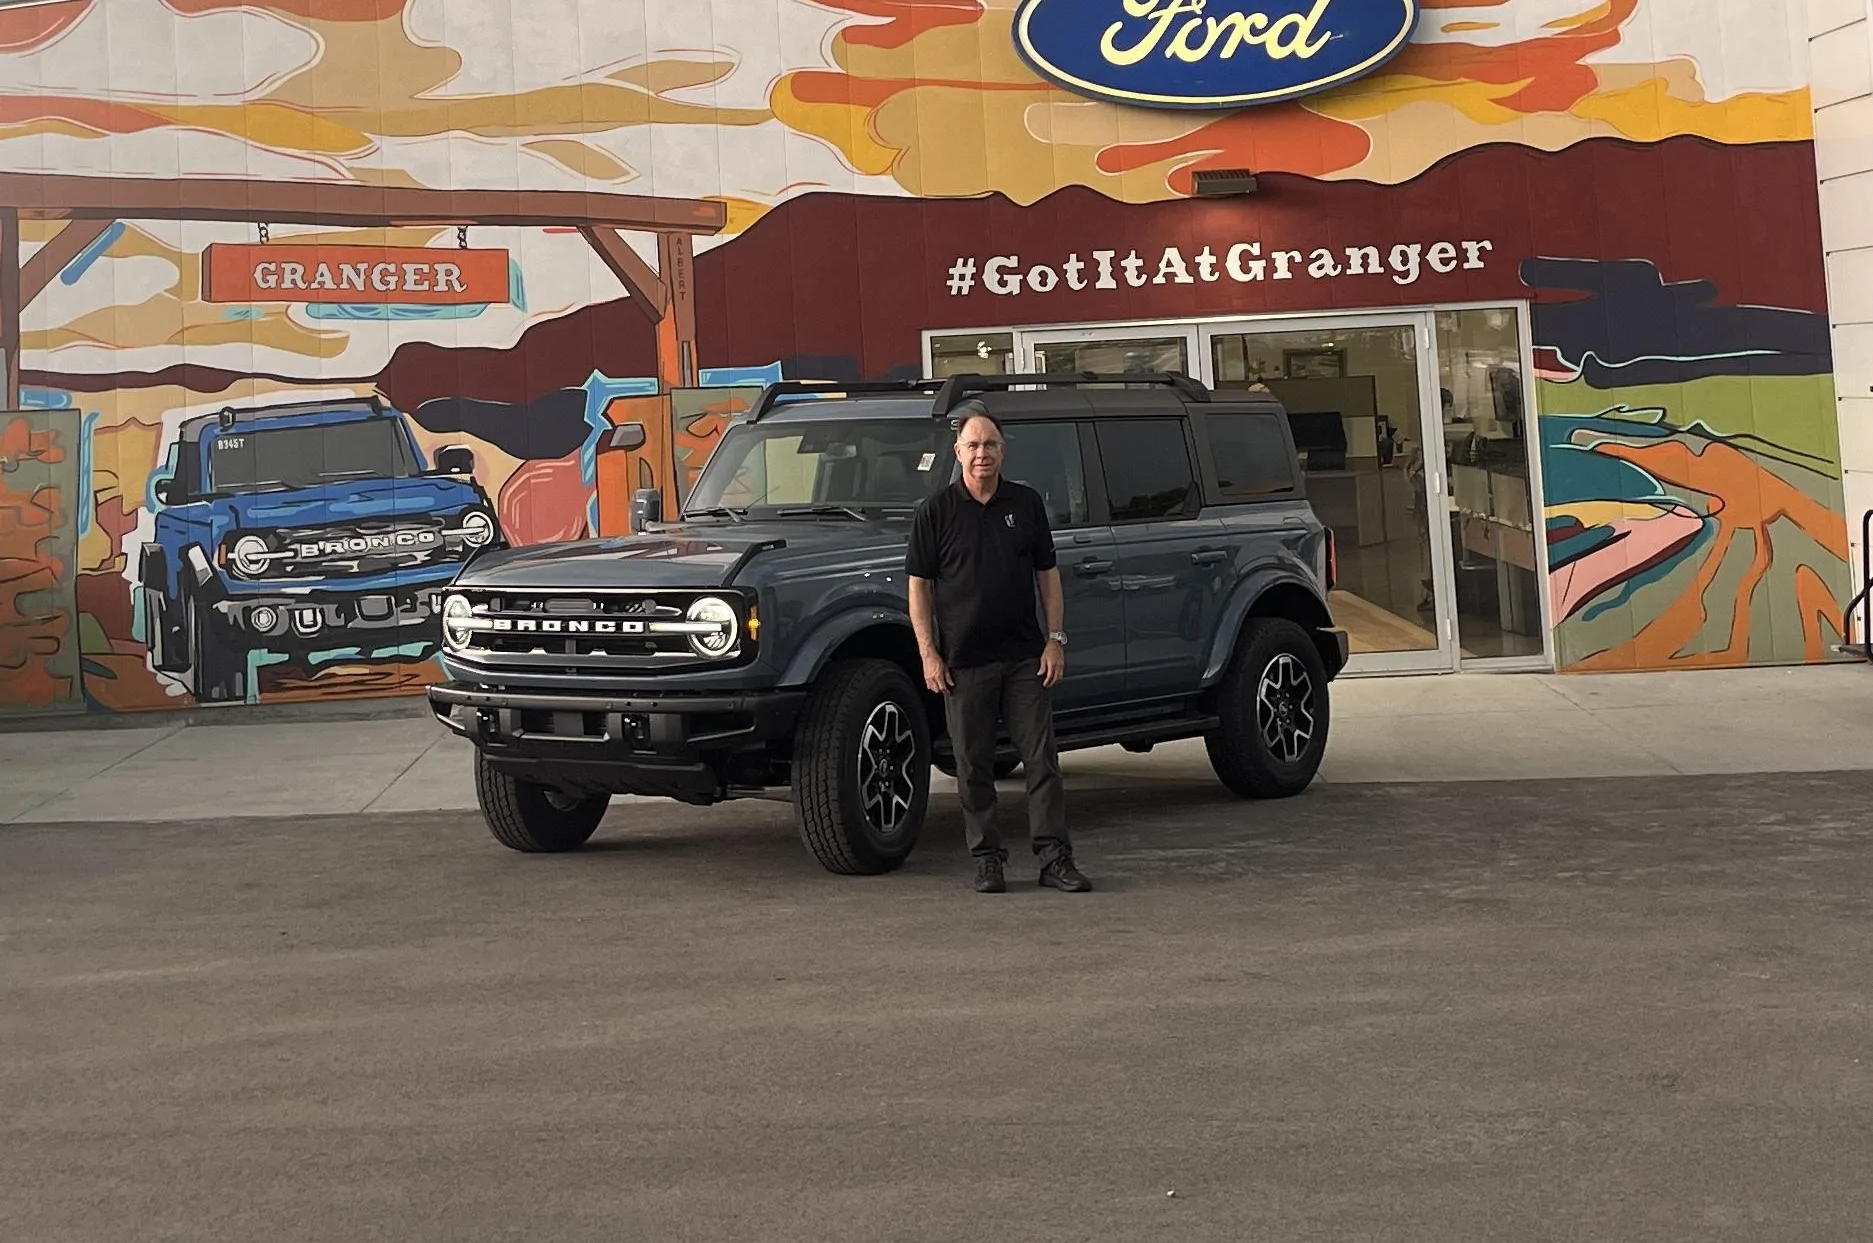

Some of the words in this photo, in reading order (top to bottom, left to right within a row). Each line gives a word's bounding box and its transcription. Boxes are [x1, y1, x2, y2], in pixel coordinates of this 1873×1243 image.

[252, 261, 468, 293] GRANGER
[675, 236, 687, 301] ALBERT
[944, 239, 1494, 296] #GotItAtGranger
[301, 531, 436, 557] BRONCO
[493, 619, 645, 633] BRONCO
